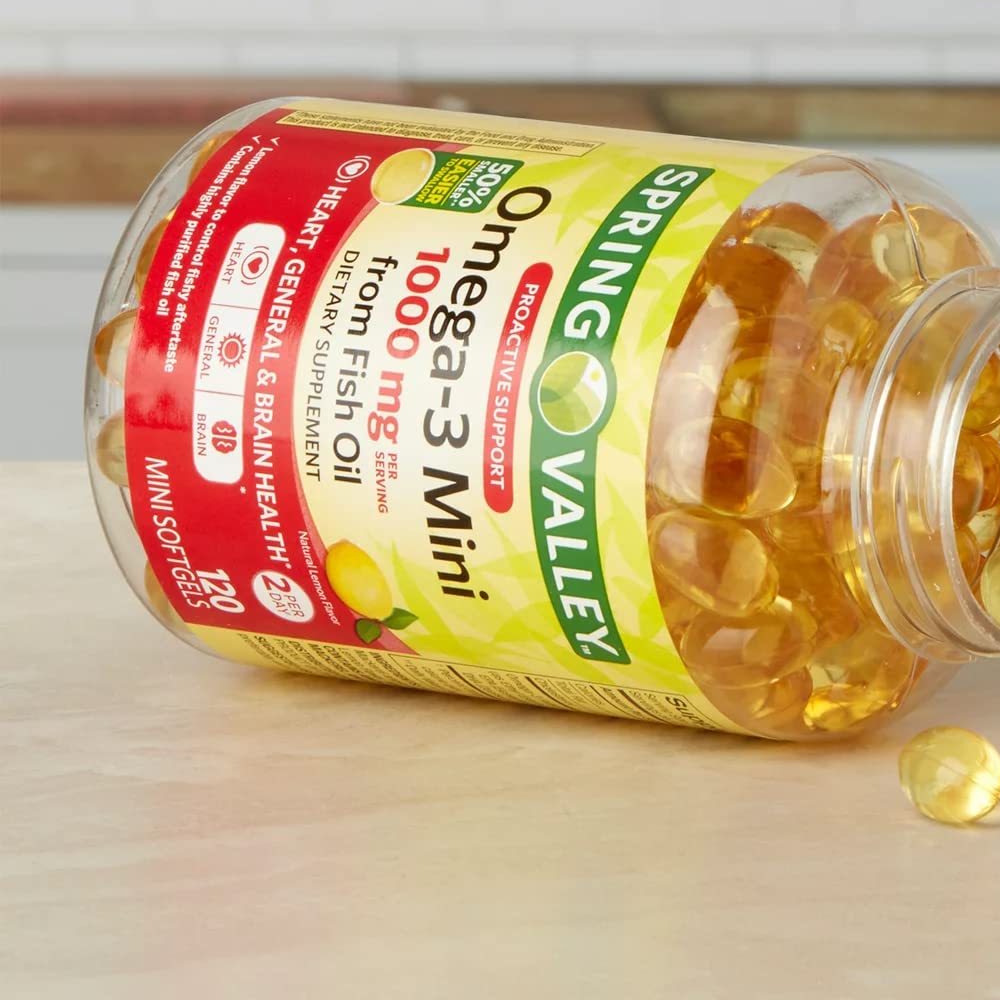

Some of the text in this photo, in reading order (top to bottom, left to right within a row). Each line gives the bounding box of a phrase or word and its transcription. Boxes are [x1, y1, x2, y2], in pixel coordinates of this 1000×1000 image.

[416, 166, 448, 202] SWALLOW
[424, 158, 477, 204] EASIER
[459, 162, 514, 207] 50%
[156, 145, 254, 317] Contains highly purified fish oil
[164, 146, 274, 373] Lemon flavor to control fishy aftertaste
[222, 241, 246, 284] HEART
[564, 168, 699, 339] SPRING
[200, 316, 220, 379] GENERAL
[260, 258, 306, 363] GENERAL
[367, 247, 450, 444] 1000 mg
[423, 186, 552, 449] Omega-3
[256, 369, 276, 386] &
[305, 250, 360, 482] DIETARY SUPPLEMENT
[333, 256, 399, 484] from Fish Oil
[489, 283, 540, 490] PROACTIVE SUPPORT
[197, 413, 207, 456] BRAIN
[253, 392, 275, 467] BRAIN
[388, 453, 398, 480] PER
[375, 452, 388, 514] SERVING
[144, 456, 211, 609] MINI SOFTGELS
[423, 466, 489, 600] Mini
[541, 449, 619, 656] VALLEY
[196, 568, 246, 614] 120
[261, 574, 291, 594] 2
[268, 592, 292, 616] DAY
[284, 590, 305, 618] PER
[298, 530, 340, 626] Natural Lemon Flavor
